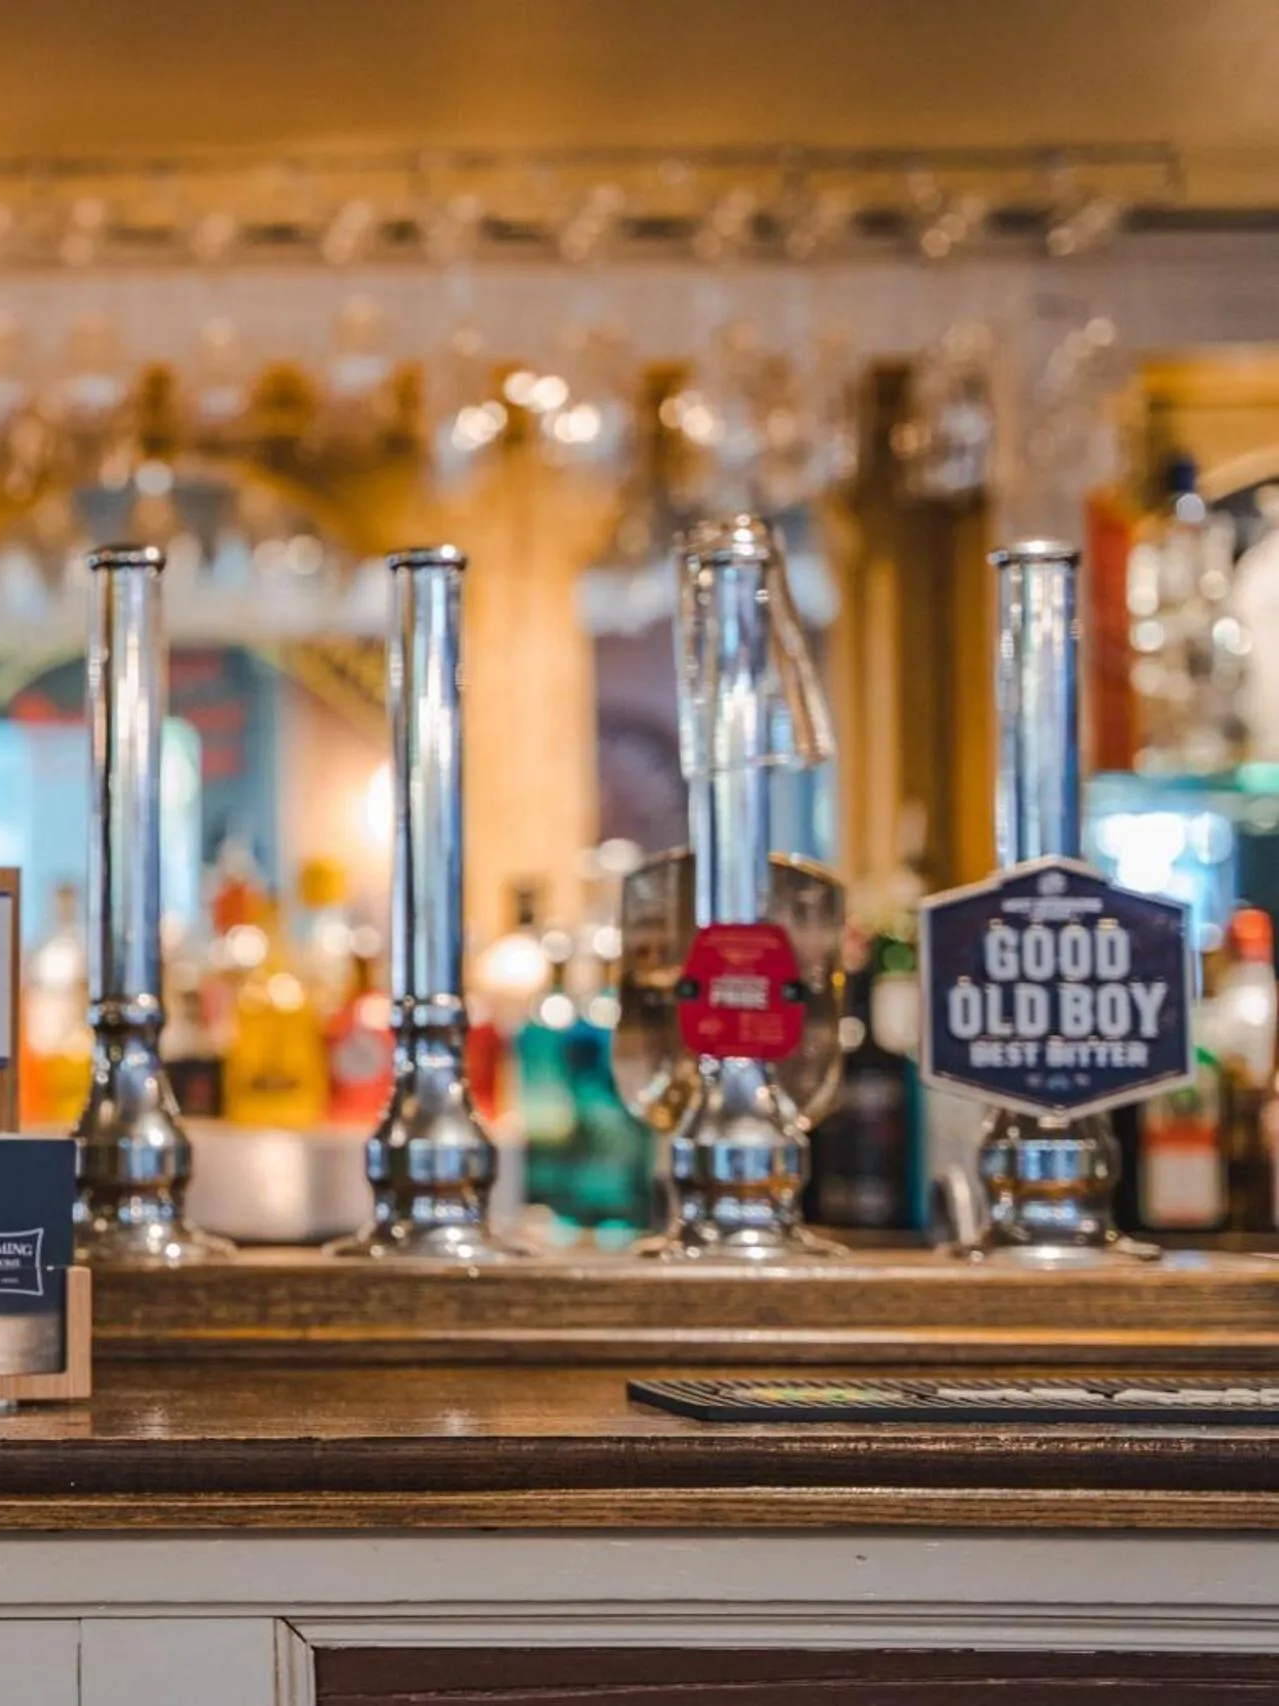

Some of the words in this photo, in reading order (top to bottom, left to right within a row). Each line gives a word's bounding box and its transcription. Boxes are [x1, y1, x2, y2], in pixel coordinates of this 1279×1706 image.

[985, 924, 1131, 982] GOOD
[948, 981, 1050, 1040] OLD
[1058, 981, 1168, 1040] BOY
